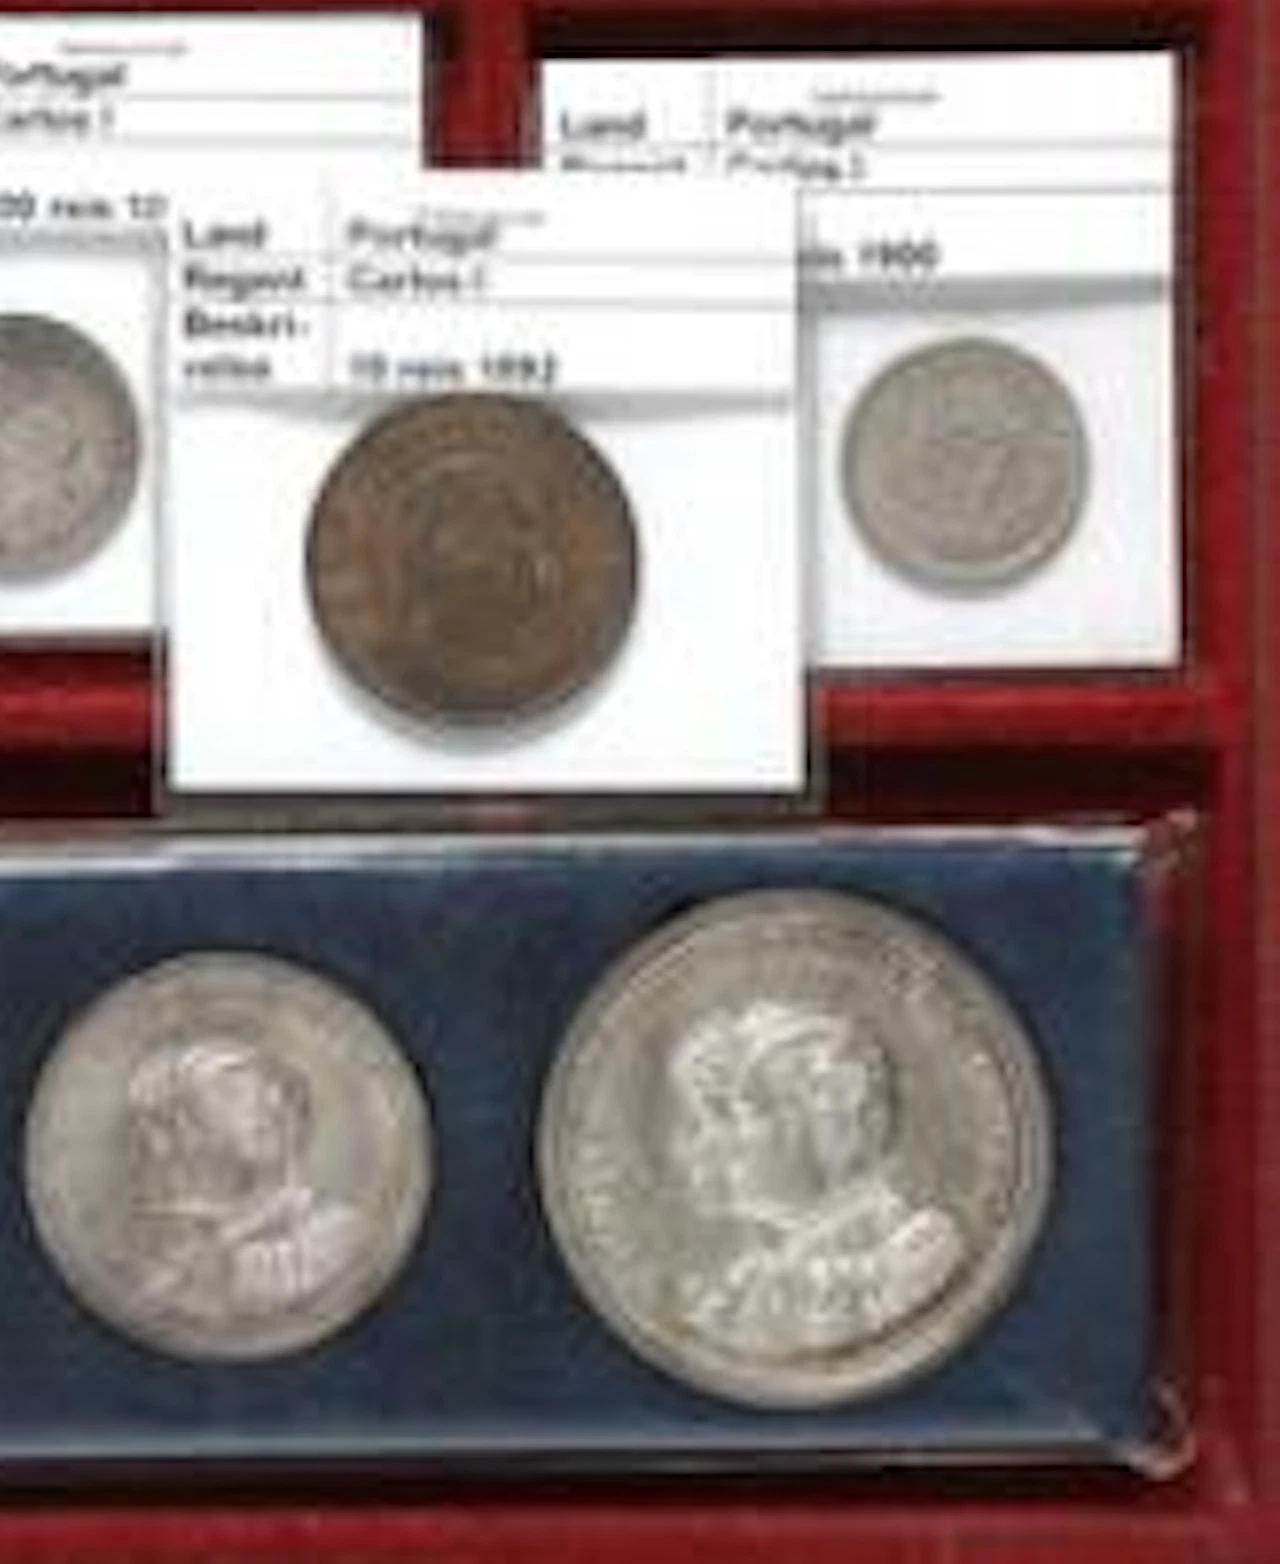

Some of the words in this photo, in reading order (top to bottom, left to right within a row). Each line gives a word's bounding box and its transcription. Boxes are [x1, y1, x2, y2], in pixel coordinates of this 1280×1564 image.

[558, 111, 648, 144] Land
[724, 108, 877, 150] Portugal
[181, 219, 269, 252] Land
[346, 216, 499, 260] Portugal
[180, 260, 307, 305] Regent
[346, 263, 463, 296] Carlos
[182, 353, 273, 384] velse
